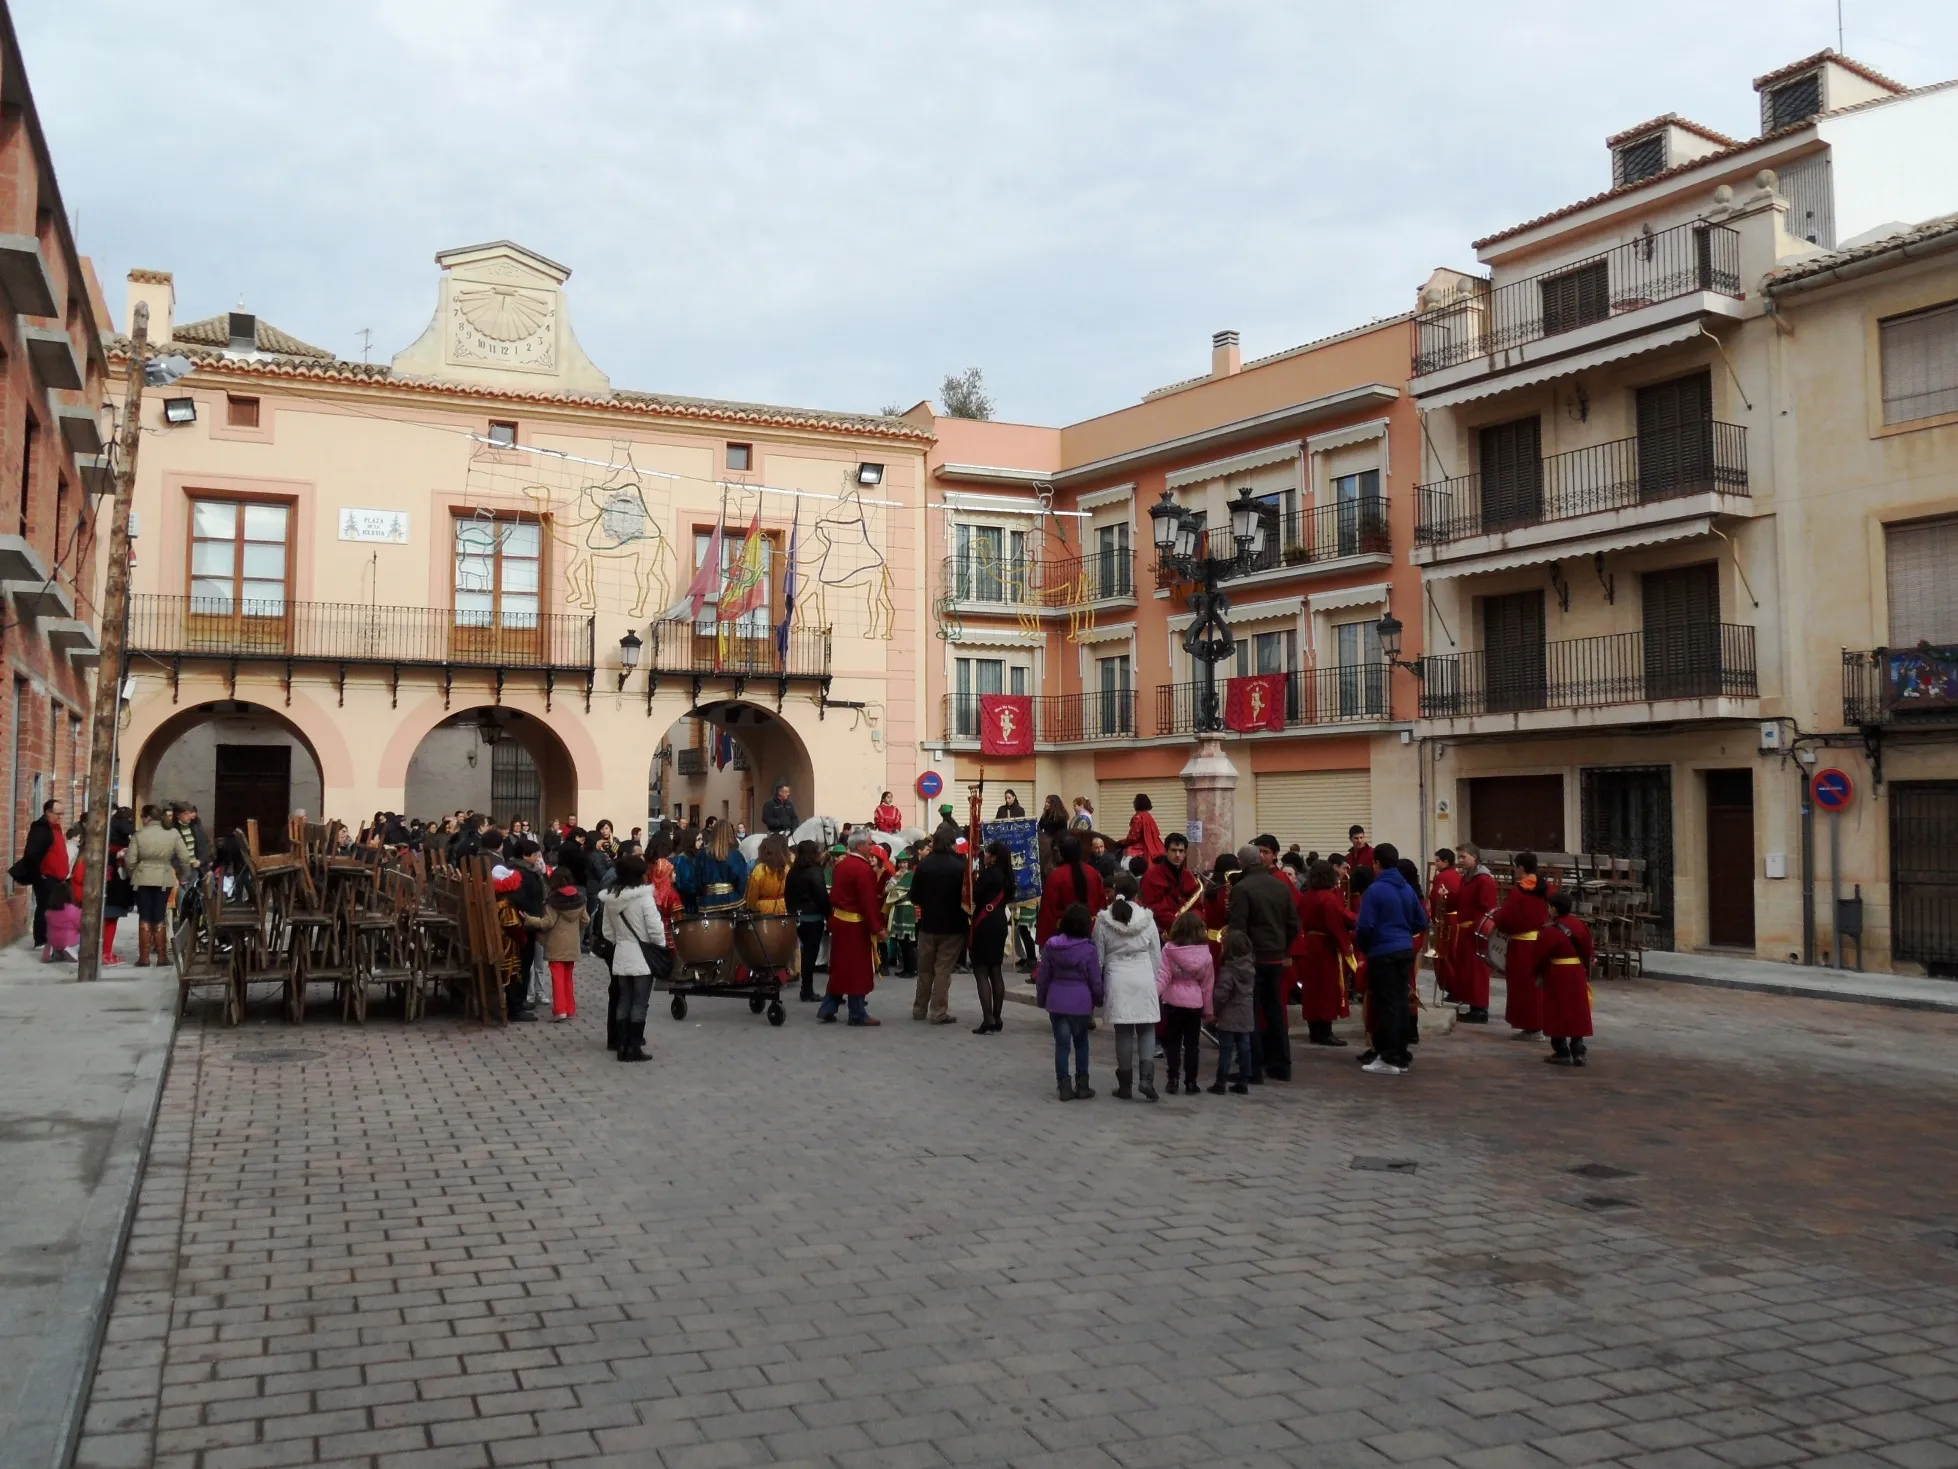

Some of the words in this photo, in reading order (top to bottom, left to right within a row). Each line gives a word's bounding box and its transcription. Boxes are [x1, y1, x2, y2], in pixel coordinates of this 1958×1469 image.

[549, 310, 555, 318] 5
[459, 322, 464, 331] 8
[545, 324, 550, 332] 4
[466, 331, 472, 339] 9
[478, 339, 486, 349] 10
[537, 337, 543, 345] 3
[489, 344, 496, 354] 11
[501, 346, 509, 355] 12
[526, 343, 532, 352] 2
[364, 516, 384, 524] PLAZA
